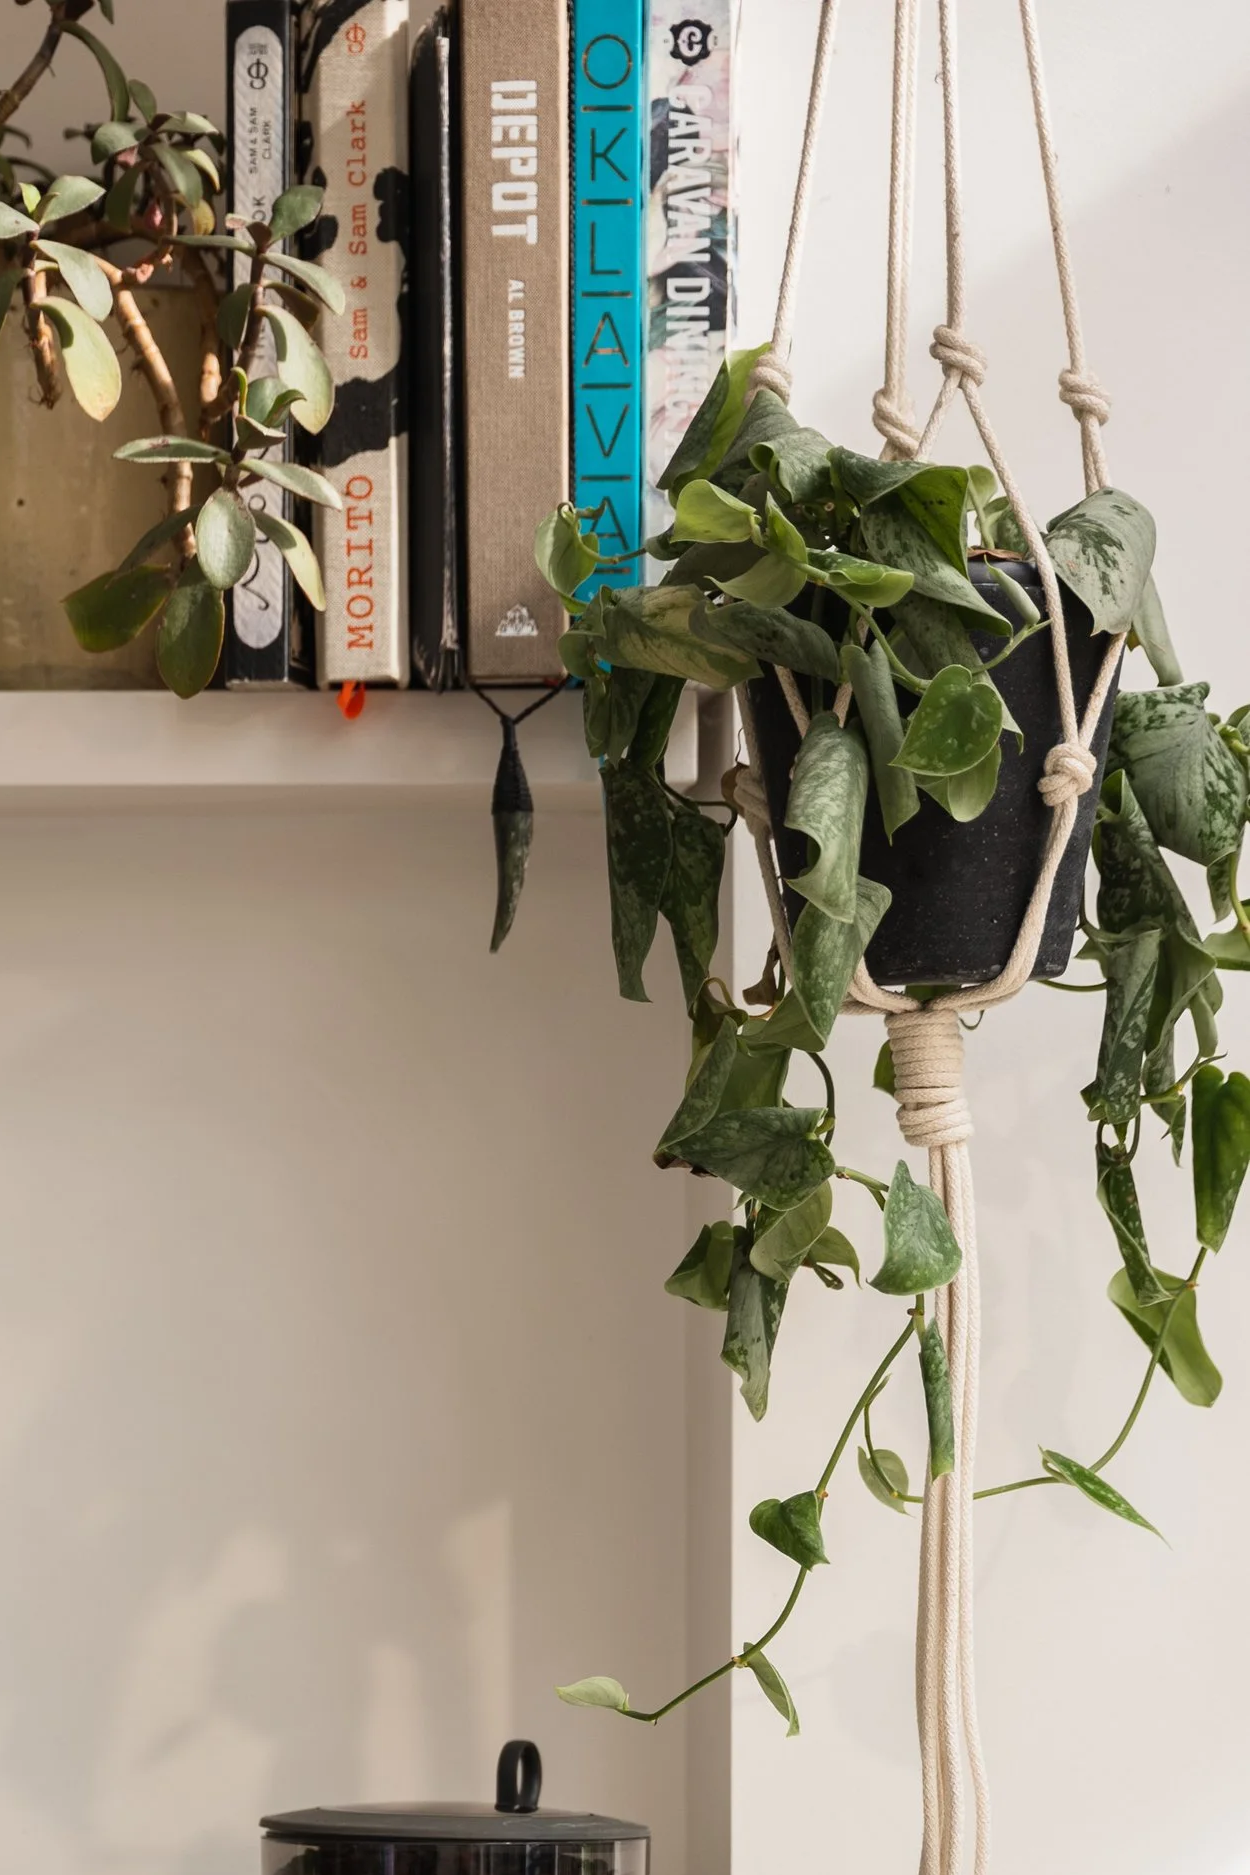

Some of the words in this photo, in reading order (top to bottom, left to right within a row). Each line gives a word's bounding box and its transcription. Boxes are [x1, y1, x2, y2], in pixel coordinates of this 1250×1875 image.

[261, 120, 271, 160] CLARK
[346, 99, 367, 187] Clark
[491, 80, 538, 245] DEPOT
[666, 83, 713, 263] CARAVAN
[349, 203, 367, 256] Sam
[351, 275, 367, 289] &
[508, 279, 526, 303] AL
[349, 307, 368, 360] Sam
[508, 309, 526, 379] BROWN
[345, 474, 374, 650] MORITO
